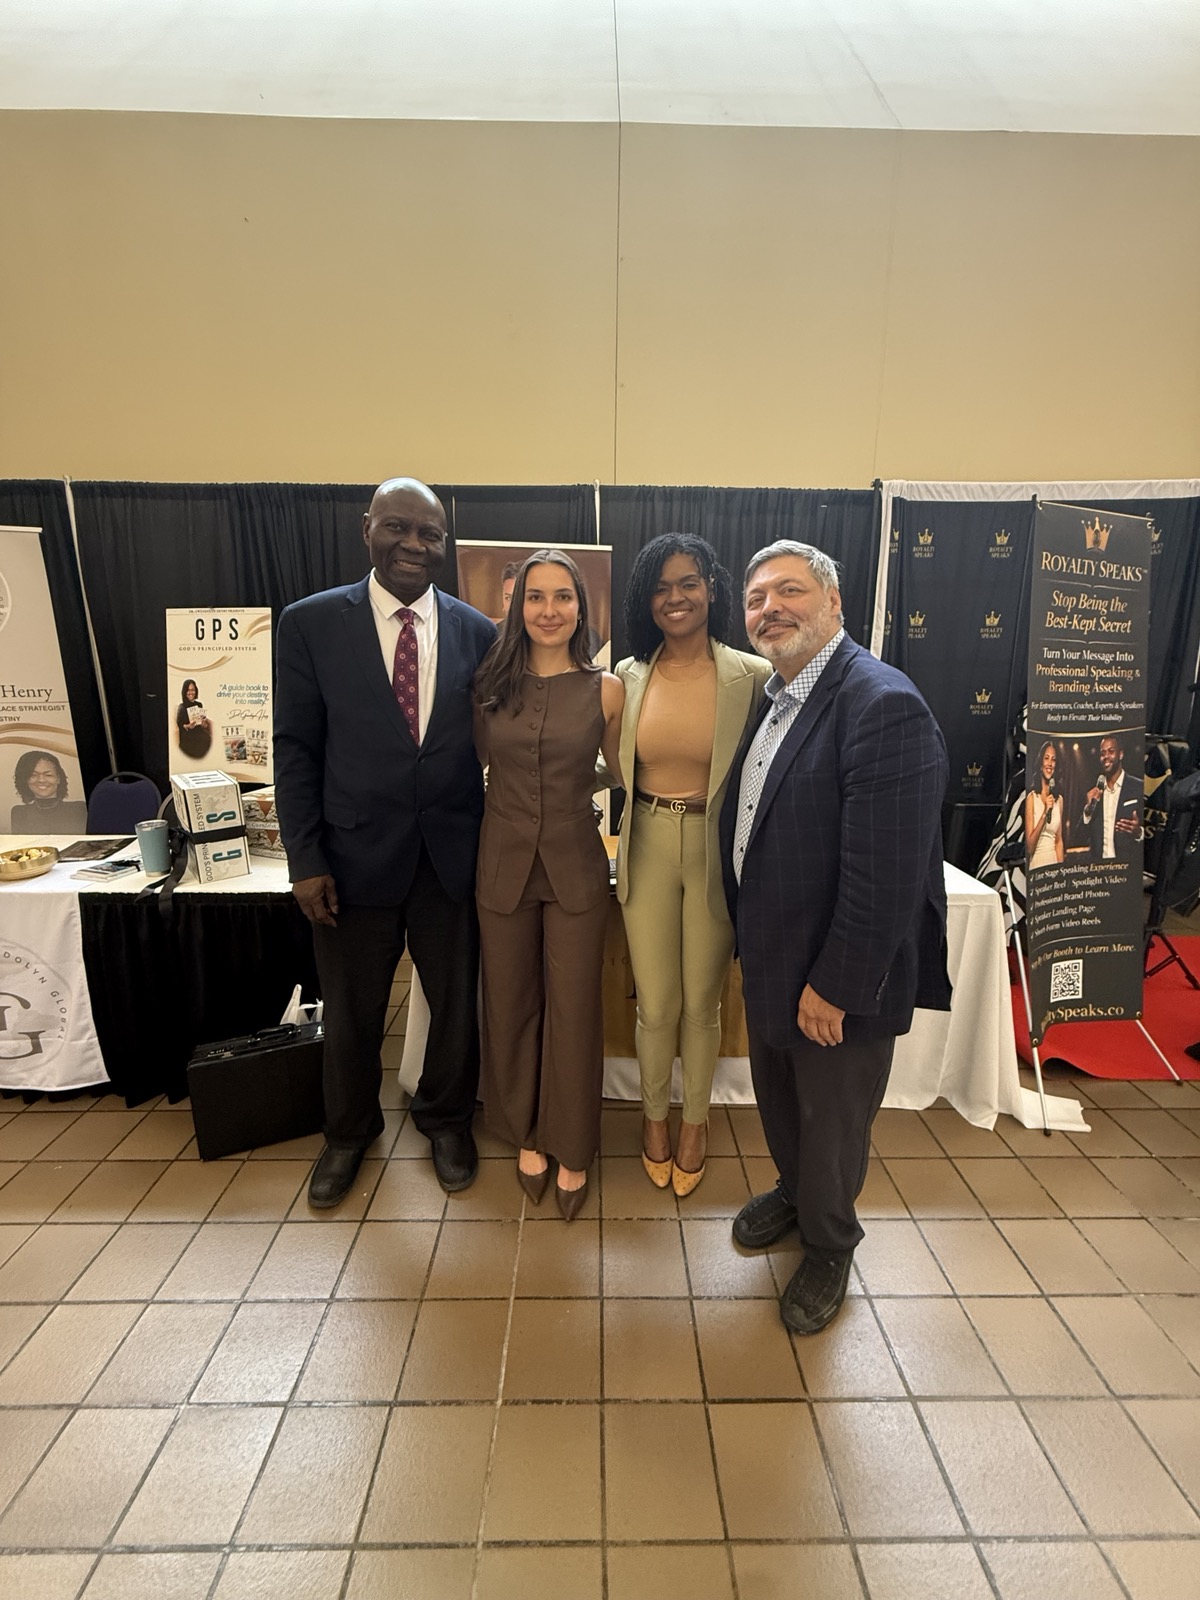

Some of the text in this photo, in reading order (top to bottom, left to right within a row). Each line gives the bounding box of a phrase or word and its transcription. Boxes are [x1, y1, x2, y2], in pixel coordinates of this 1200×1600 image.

[1041, 552, 1098, 576] ROYALTY
[1051, 590, 1128, 616] Stop Being the
[1045, 612, 1132, 635] Best-Kept Secret
[1043, 648, 1134, 664] Turn Your Message Into
[1036, 664, 1140, 681] Professional Speaking &
[0, 684, 52, 702] Henry
[228, 684, 244, 693] guide
[1049, 680, 1123, 696] Branding Assets
[1095, 702, 1114, 710] Experts
[1120, 702, 1144, 710] Speakers
[193, 793, 203, 820] SYSTEM
[204, 860, 213, 882] GOD'S
[1044, 869, 1059, 878] Stage
[1060, 864, 1089, 876] Speaking
[1090, 862, 1129, 872] Experience
[1035, 884, 1053, 895] Speaker
[1054, 881, 1066, 890] Reel
[1072, 876, 1102, 888] Spotlight
[1104, 875, 1127, 884] Video
[1035, 889, 1110, 908] Professional Brand Photos
[1035, 905, 1096, 924] Speaker Landing Page
[1061, 920, 1080, 928] Video
[1082, 917, 1101, 926] Reels
[1053, 946, 1073, 958] Booth
[1075, 946, 1083, 954] to
[1085, 945, 1108, 954] Learn
